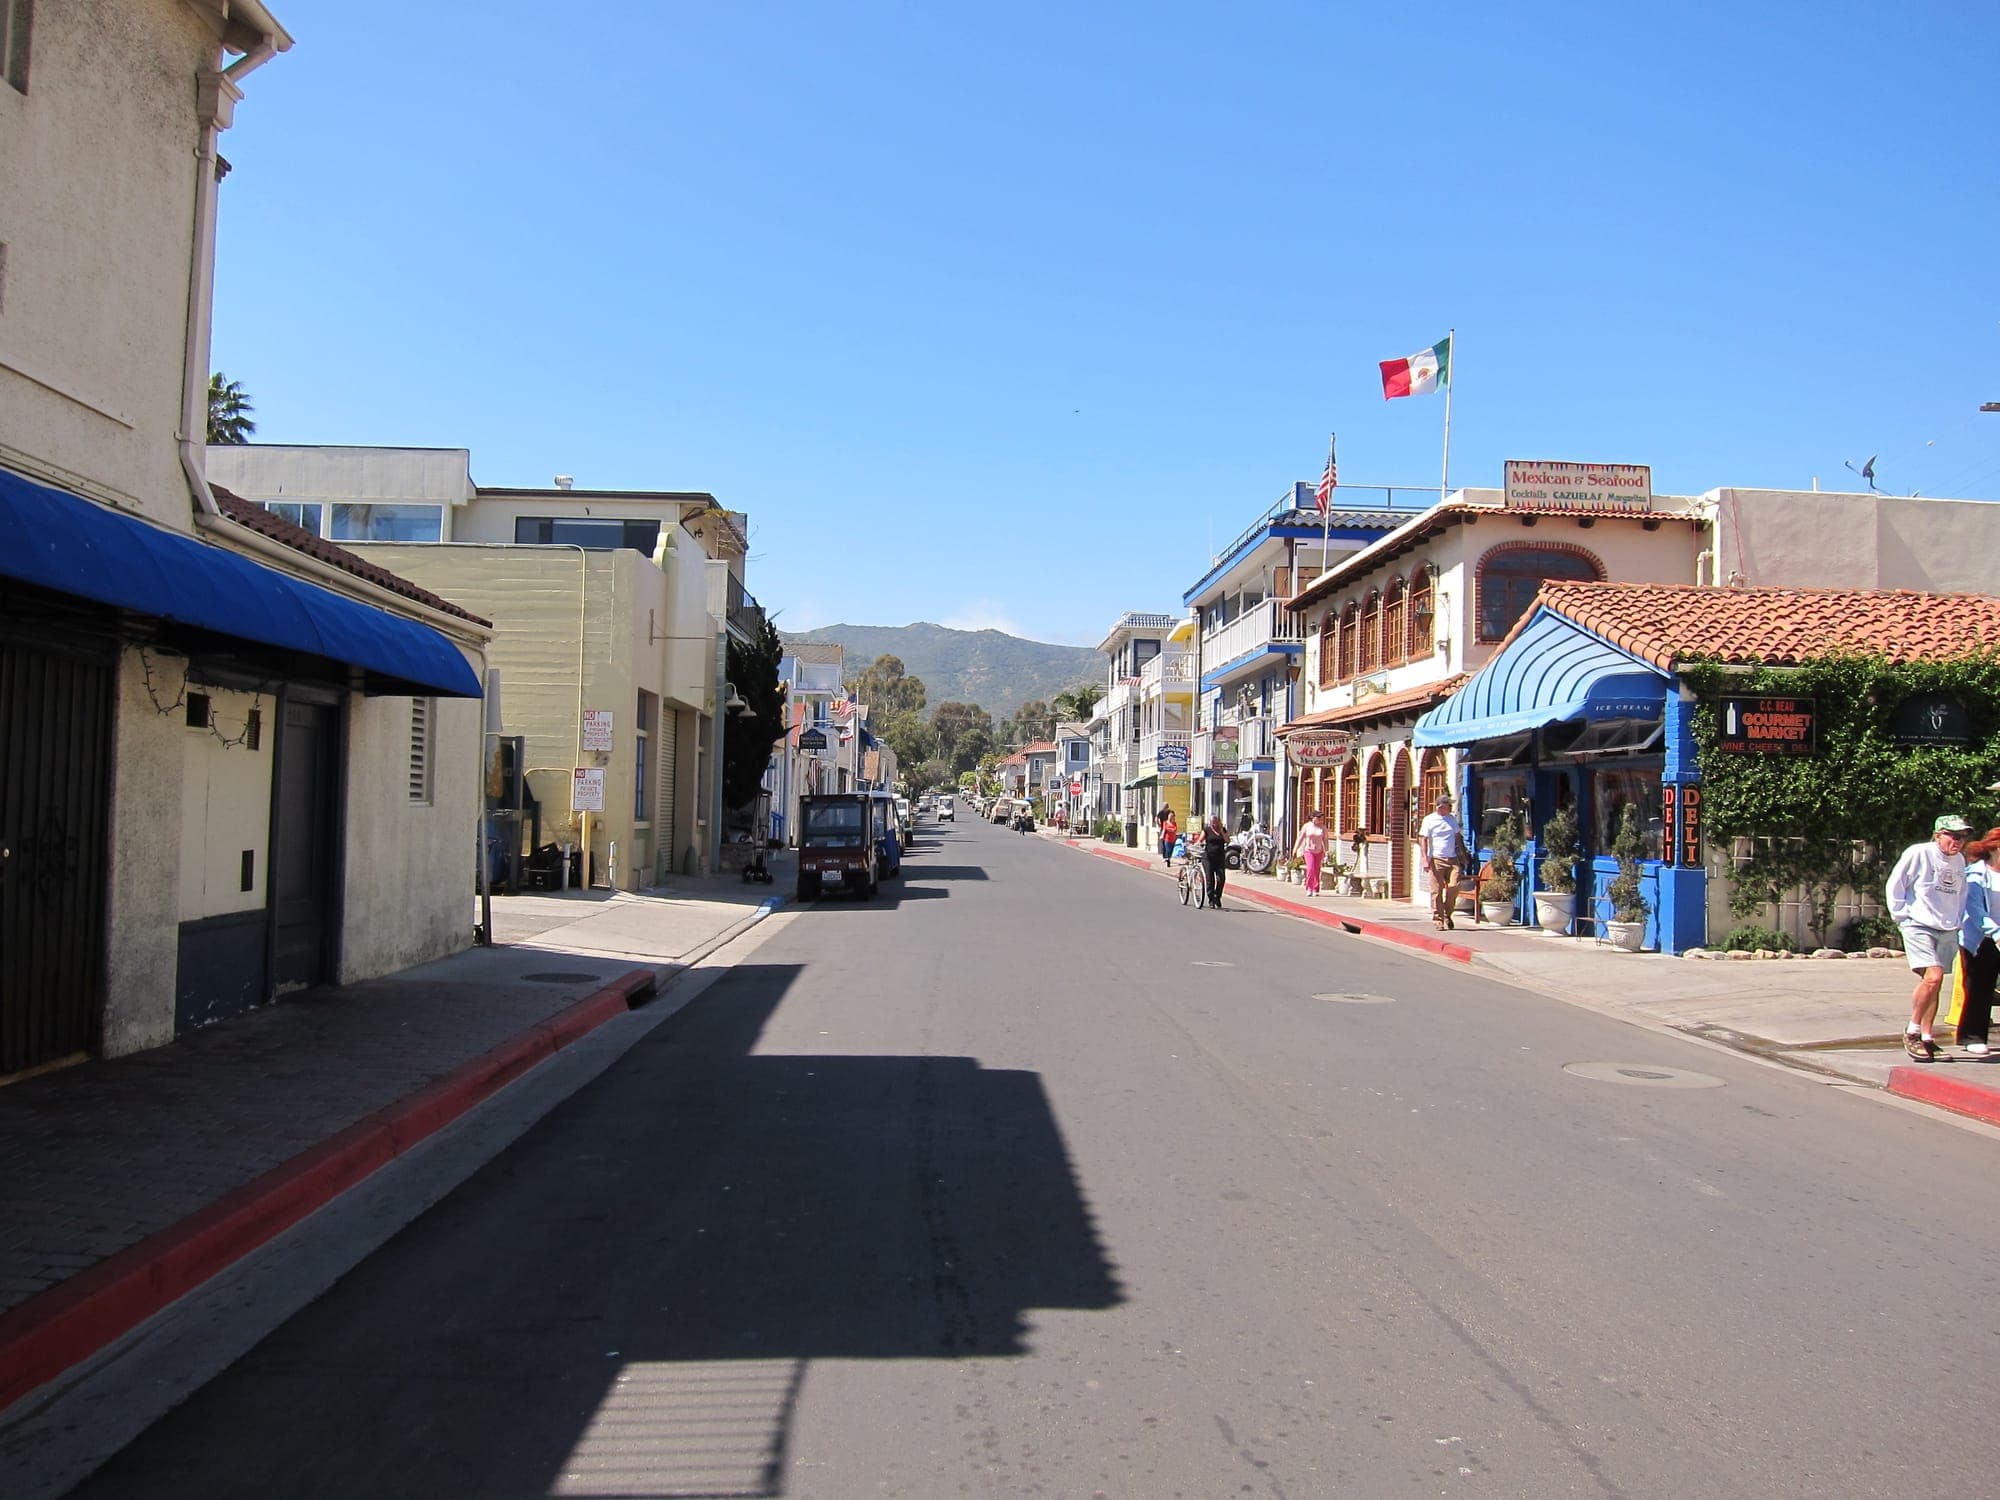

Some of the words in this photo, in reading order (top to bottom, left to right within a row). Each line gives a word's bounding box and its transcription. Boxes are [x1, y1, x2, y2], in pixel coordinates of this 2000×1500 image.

[1512, 471, 1571, 486] Mexican
[1587, 473, 1644, 488] Seafood
[1595, 704, 1612, 712] ICE
[1615, 704, 1651, 712] CREAM
[583, 712, 594, 720] NO
[1742, 712, 1812, 727] GOURMET
[1747, 726, 1807, 740] MARKET
[1297, 746, 1313, 757] Mi
[1720, 742, 1745, 751] WINE
[1748, 743, 1785, 752] CHEESE
[1665, 789, 1673, 861] DELI
[1683, 789, 1700, 862] DELI
